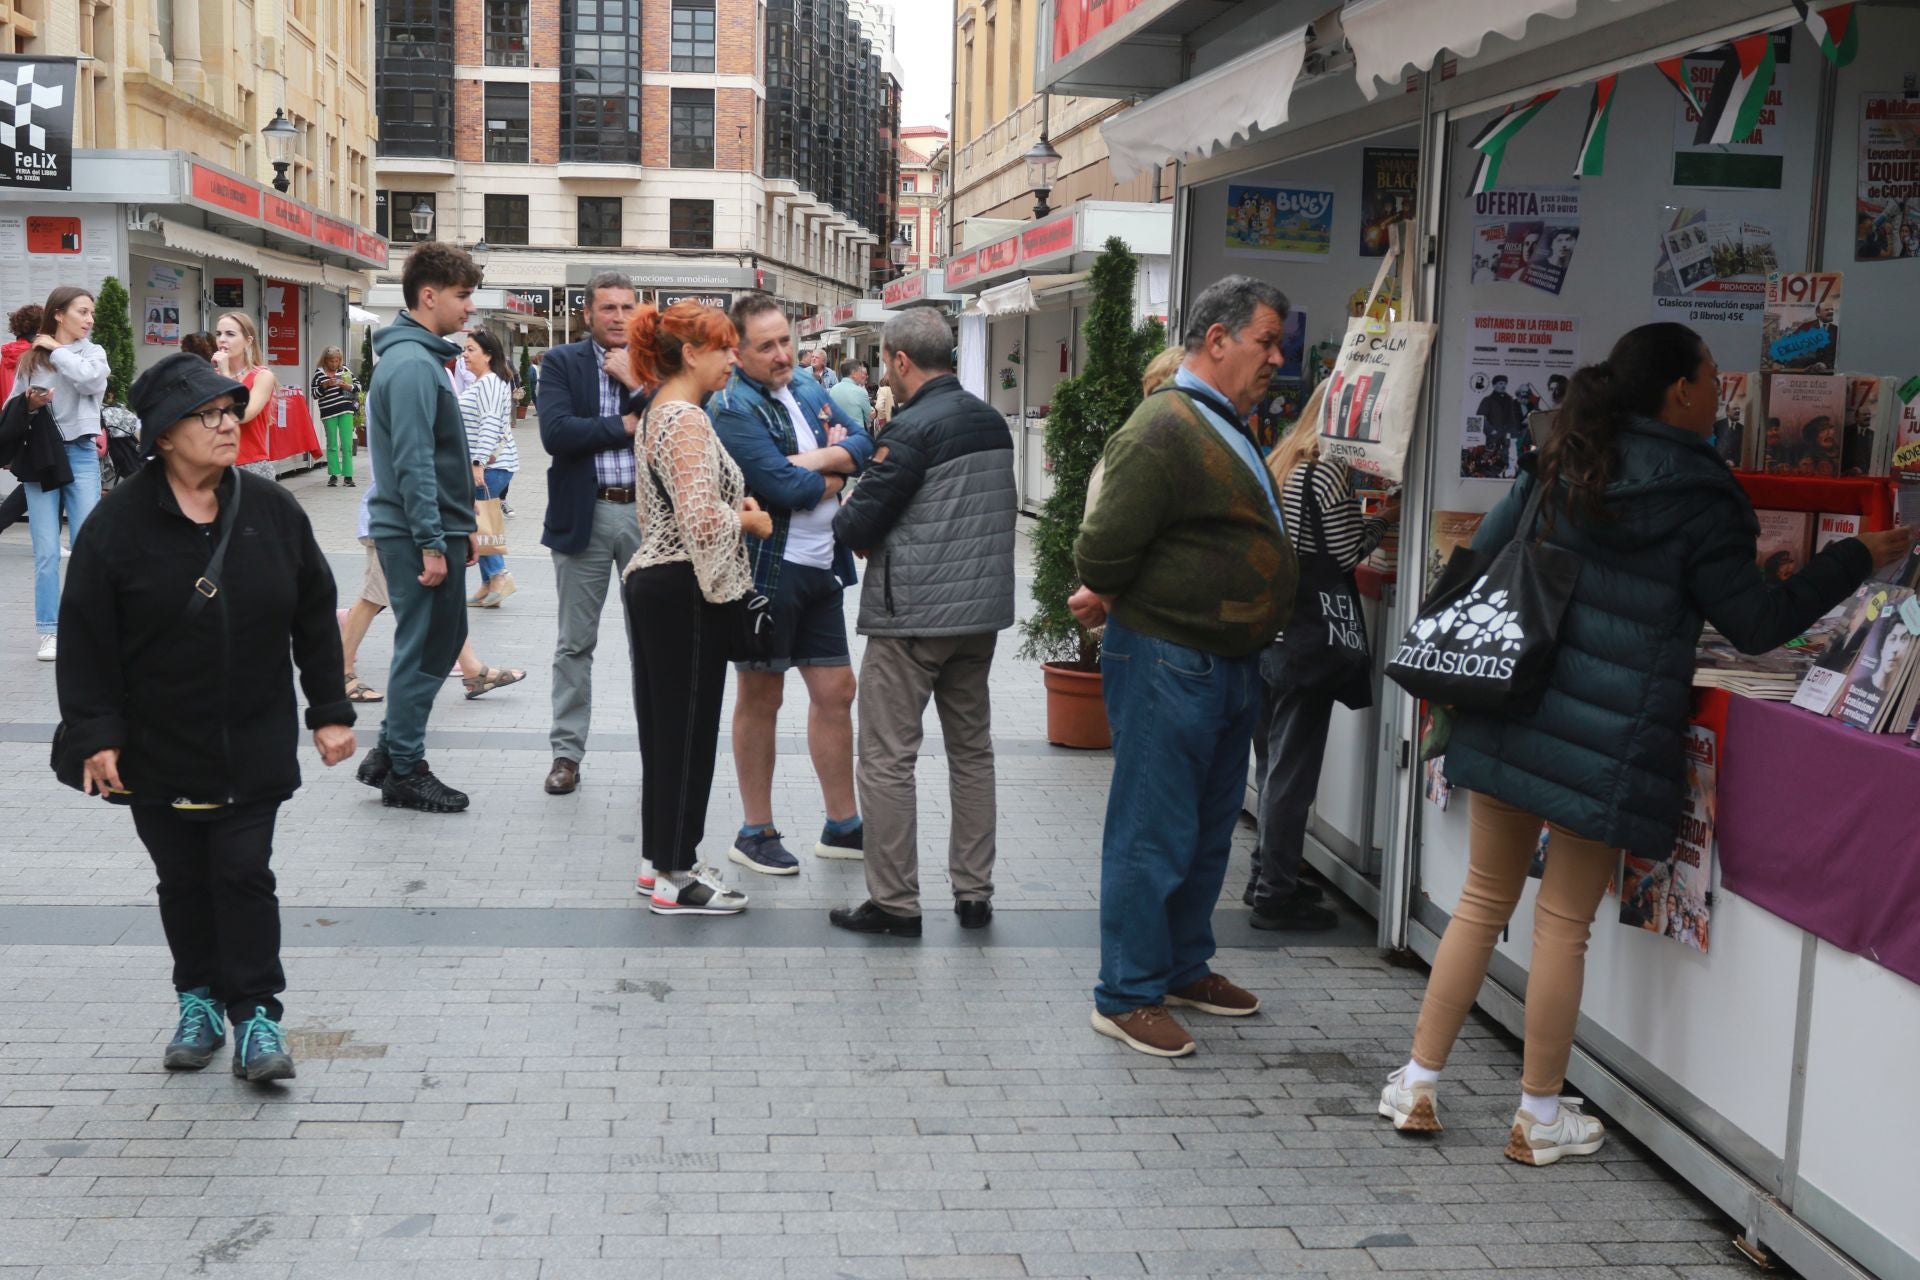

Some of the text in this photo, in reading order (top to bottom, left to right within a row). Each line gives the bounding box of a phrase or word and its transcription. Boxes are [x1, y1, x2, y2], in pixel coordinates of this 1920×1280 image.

[1868, 148, 1909, 160] Levantar
[1377, 172, 1418, 189] BLACK
[1868, 162, 1920, 184] IZQUIE
[1868, 186, 1881, 198] de
[1476, 192, 1538, 215] OFERTA
[630, 275, 729, 285] omociones inmobiliarias
[1781, 276, 1837, 303] 1917
[1658, 298, 1692, 308] Clasicos
[1694, 299, 1738, 310] revolución
[1740, 300, 1764, 312] españ
[1700, 310, 1726, 322] libros)
[1727, 312, 1744, 322] 45€
[1475, 316, 1573, 332] VISÍTANOS EN LA FERIA DEL
[1370, 337, 1407, 351] CALM
[1494, 332, 1552, 345] LIBRO DE XIXÓN
[1720, 376, 1744, 402] 17
[1851, 380, 1876, 410] 17
[1903, 406, 1917, 420] EL
[1907, 420, 1920, 434] JU
[1330, 443, 1366, 457] DENTRO
[1897, 444, 1920, 464] NOVE
[1350, 457, 1380, 472] LIBROS
[1822, 518, 1854, 533] Mi vida
[1843, 693, 1875, 715] feminismo
